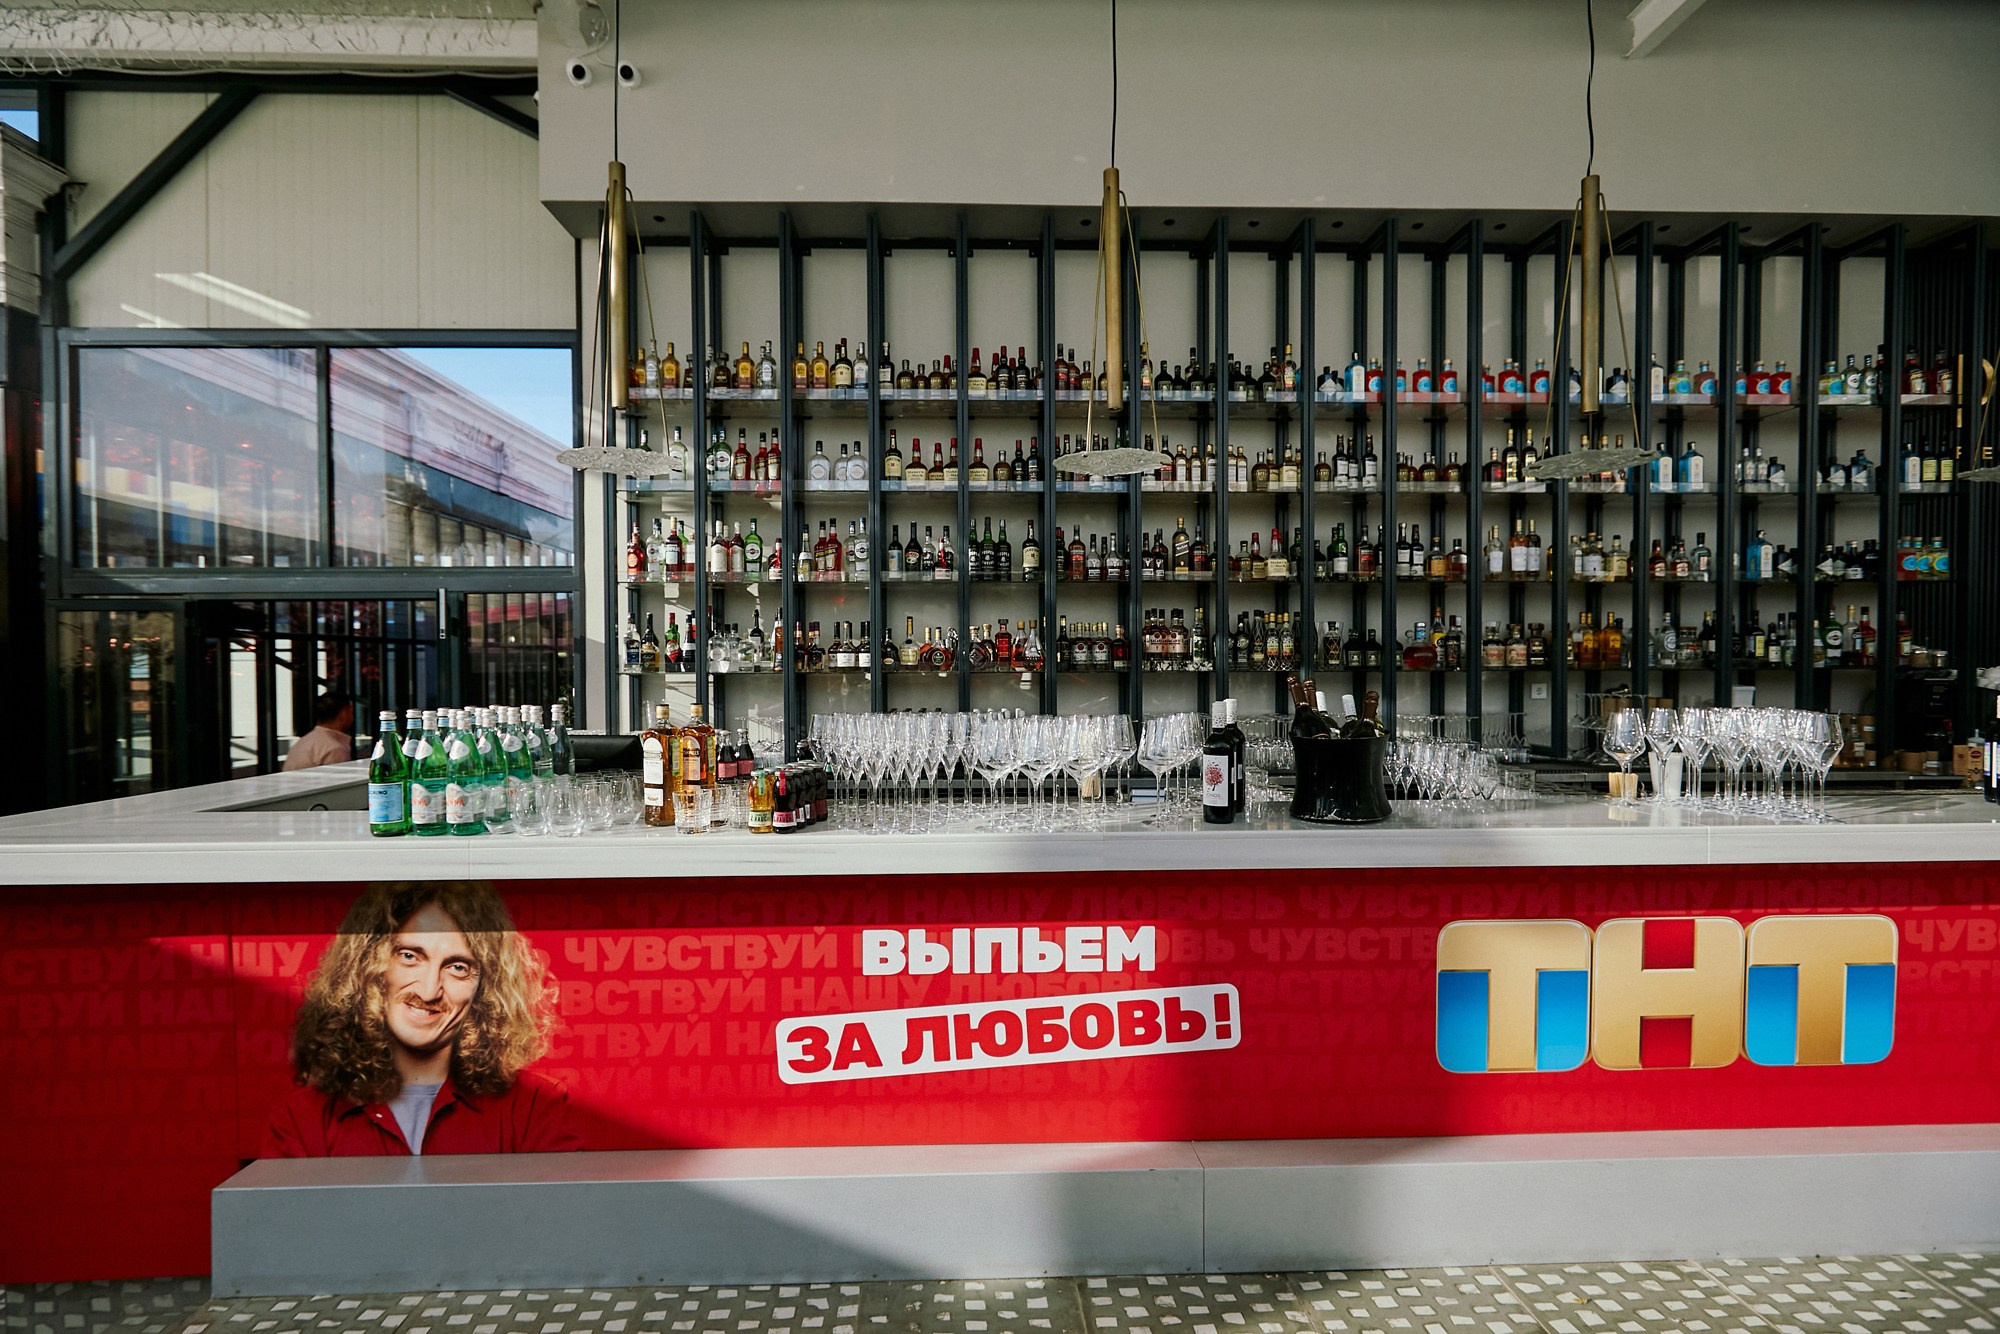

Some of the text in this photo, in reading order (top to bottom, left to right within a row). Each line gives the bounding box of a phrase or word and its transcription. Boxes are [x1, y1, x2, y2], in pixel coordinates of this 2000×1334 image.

[564, 926, 838, 973] ЧУВСТВУЙ
[862, 926, 1156, 975] ВЫПЬЕМ
[1905, 918, 2000, 953] ЧУВ
[560, 969, 766, 1017] ВСТВУЙ
[1436, 914, 1899, 1074] ТНТ
[787, 1022, 883, 1073] ЗА
[902, 992, 1233, 1065] ЛЮБОВЬ!
